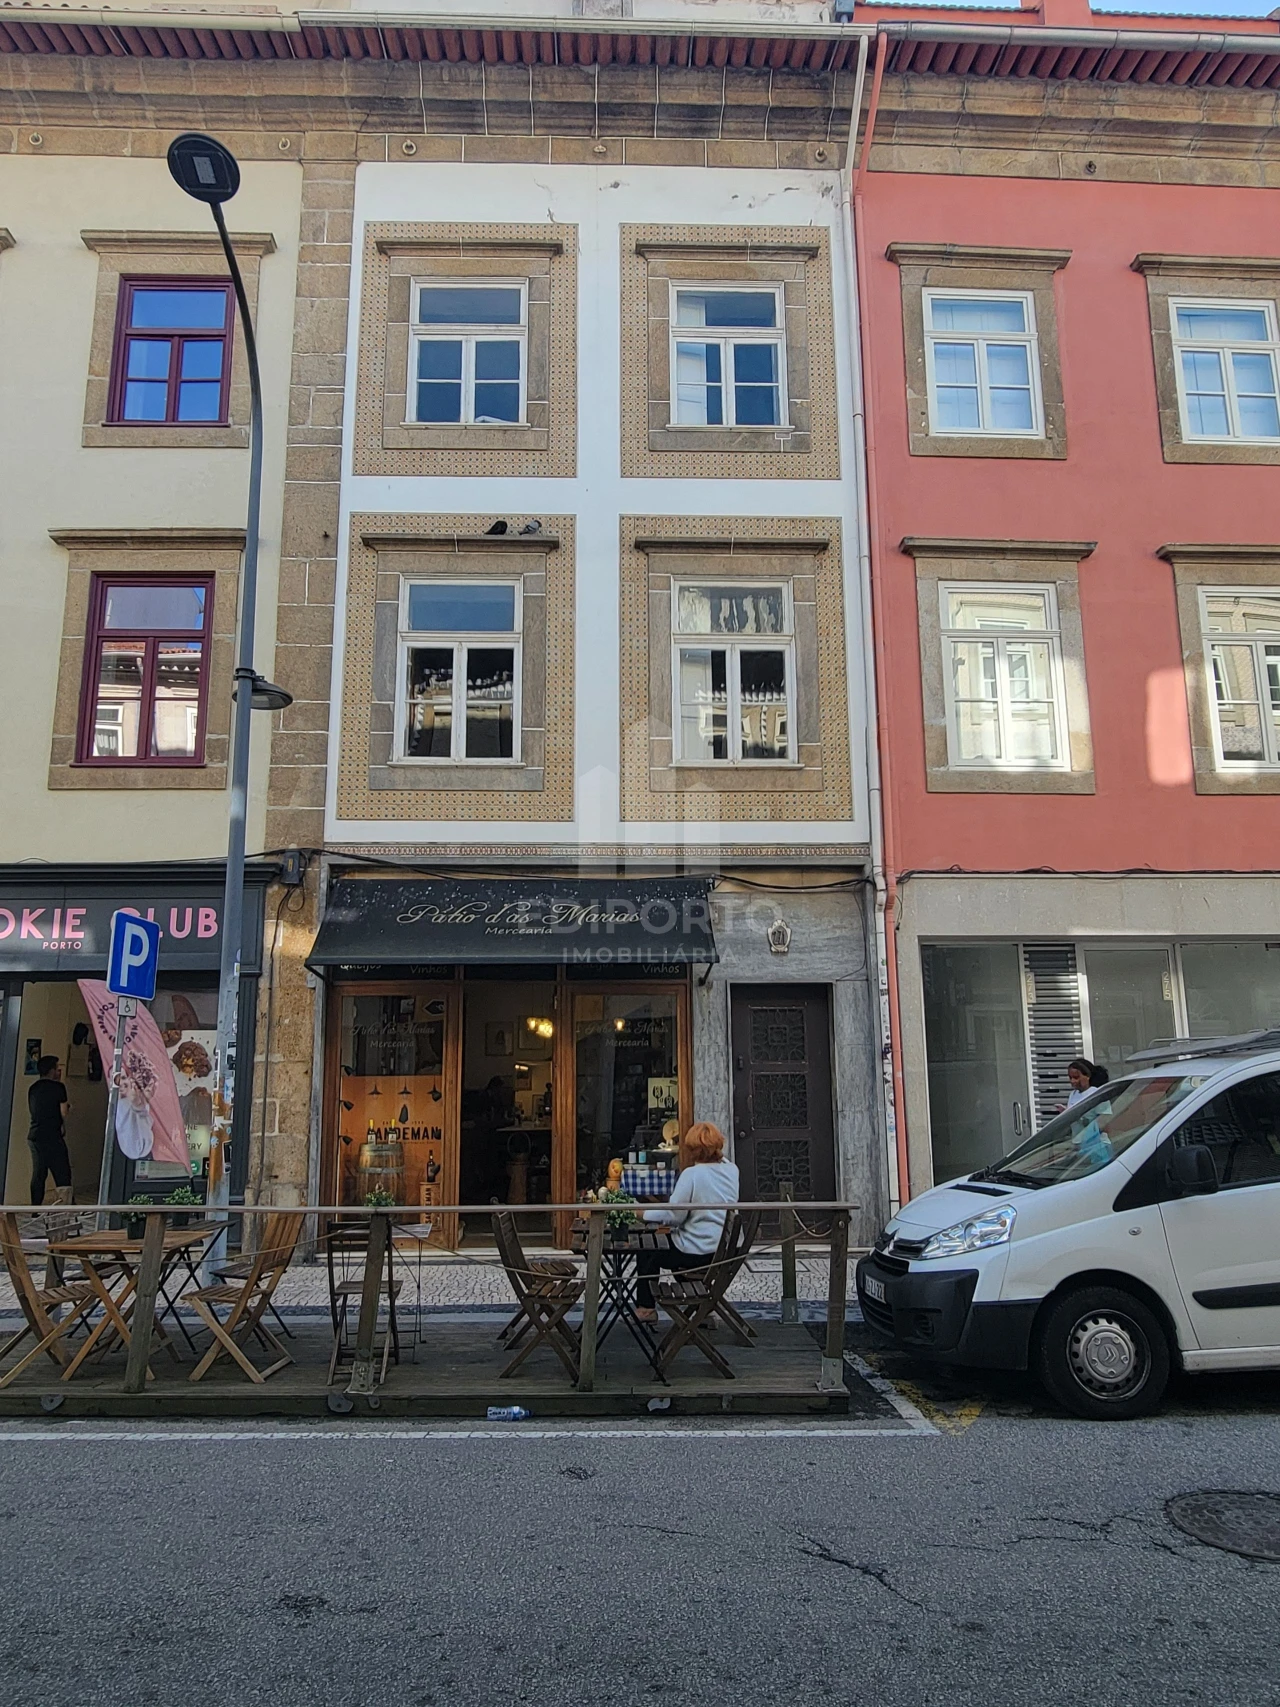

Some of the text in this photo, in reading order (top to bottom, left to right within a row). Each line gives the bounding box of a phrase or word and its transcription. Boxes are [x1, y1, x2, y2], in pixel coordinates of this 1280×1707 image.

[396, 901, 488, 924] Pátio
[542, 903, 642, 926] Marias
[485, 926, 553, 935] Mercearia
[42, 941, 82, 950] PORTO
[119, 922, 150, 987] P
[410, 964, 448, 975] Vinhos
[642, 962, 680, 975] Vinhos
[1026, 974, 1034, 1000] 273
[1162, 972, 1172, 999] 275
[375, 1126, 442, 1141] ANDEMAN
